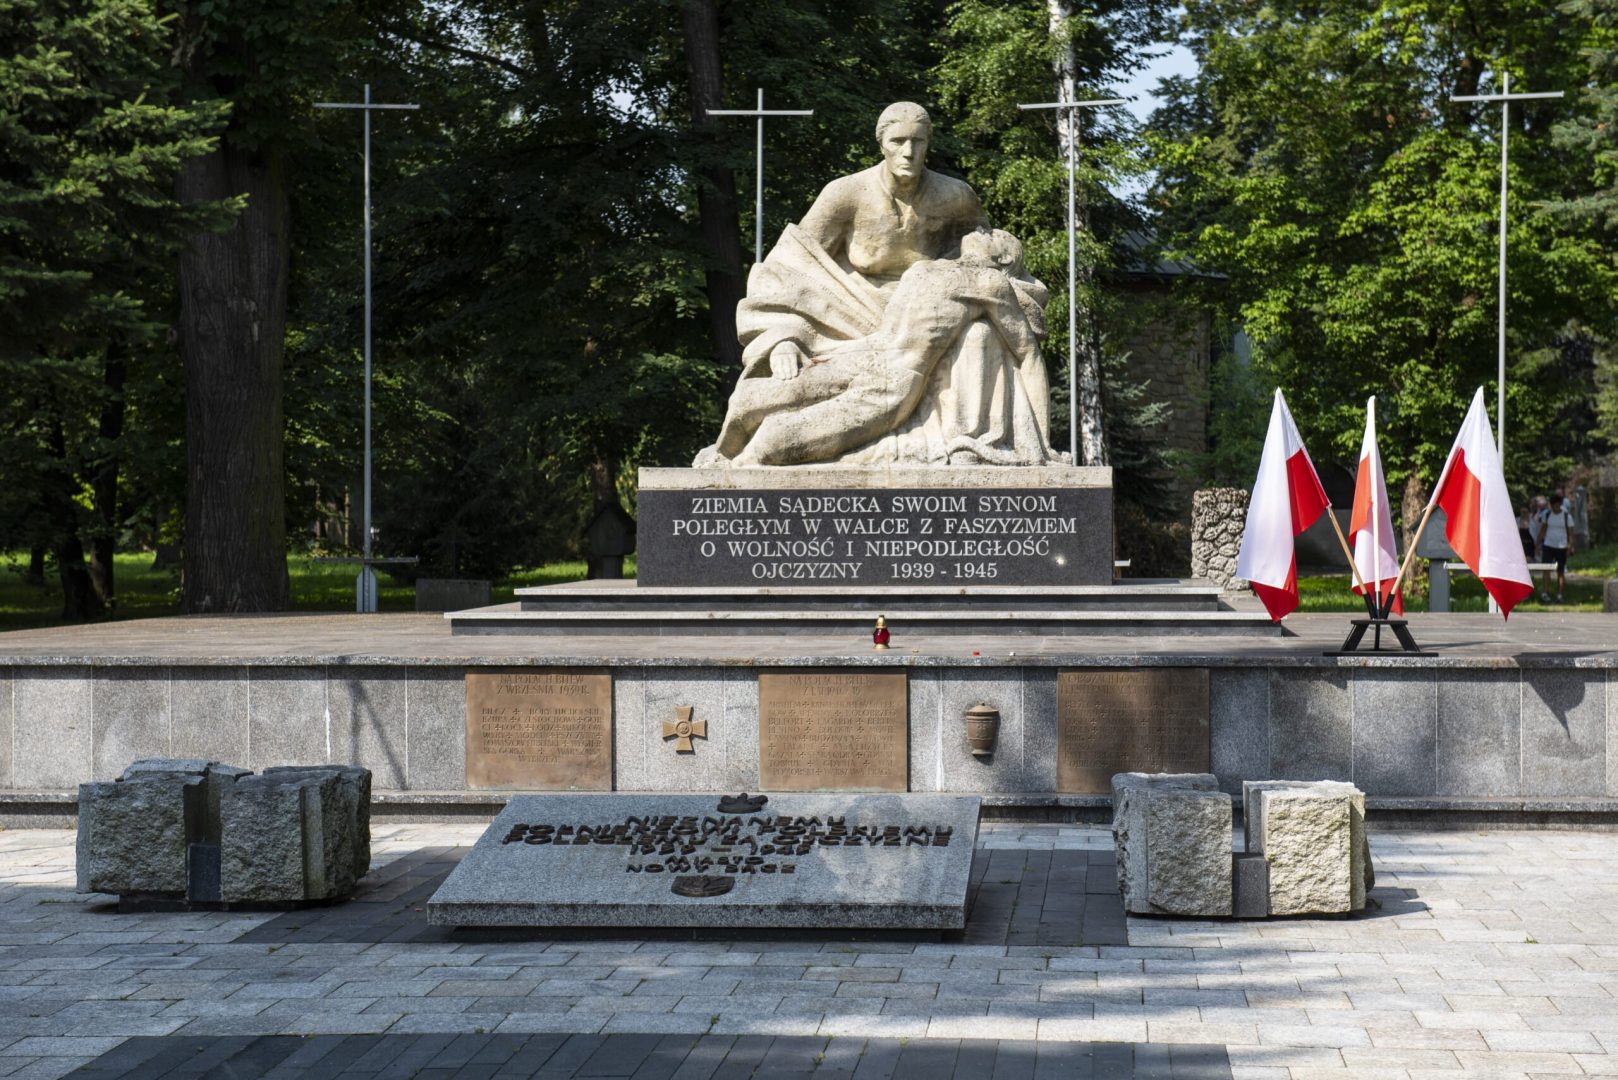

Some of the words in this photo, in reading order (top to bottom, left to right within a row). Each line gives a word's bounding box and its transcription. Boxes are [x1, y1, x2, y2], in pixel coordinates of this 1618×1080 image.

[692, 498, 768, 513] ZIEMIA
[779, 497, 881, 516] SĄDECKA
[891, 496, 967, 512] SWOIM
[979, 496, 1056, 512] SYNOM
[672, 519, 790, 535] POLEGŁYM
[802, 519, 821, 535] W
[833, 518, 909, 534] WALCE
[920, 518, 932, 534] Z
[943, 517, 1077, 533] FASZYZMEM
[701, 541, 716, 557] O
[727, 537, 834, 557] WOLNOŚĆ
[845, 540, 854, 556] I
[865, 536, 1050, 556] NIEPODLEGŁOŚĆ
[752, 562, 863, 578] OJCZYZNY
[891, 562, 934, 578] 1939
[954, 562, 998, 578] 1945
